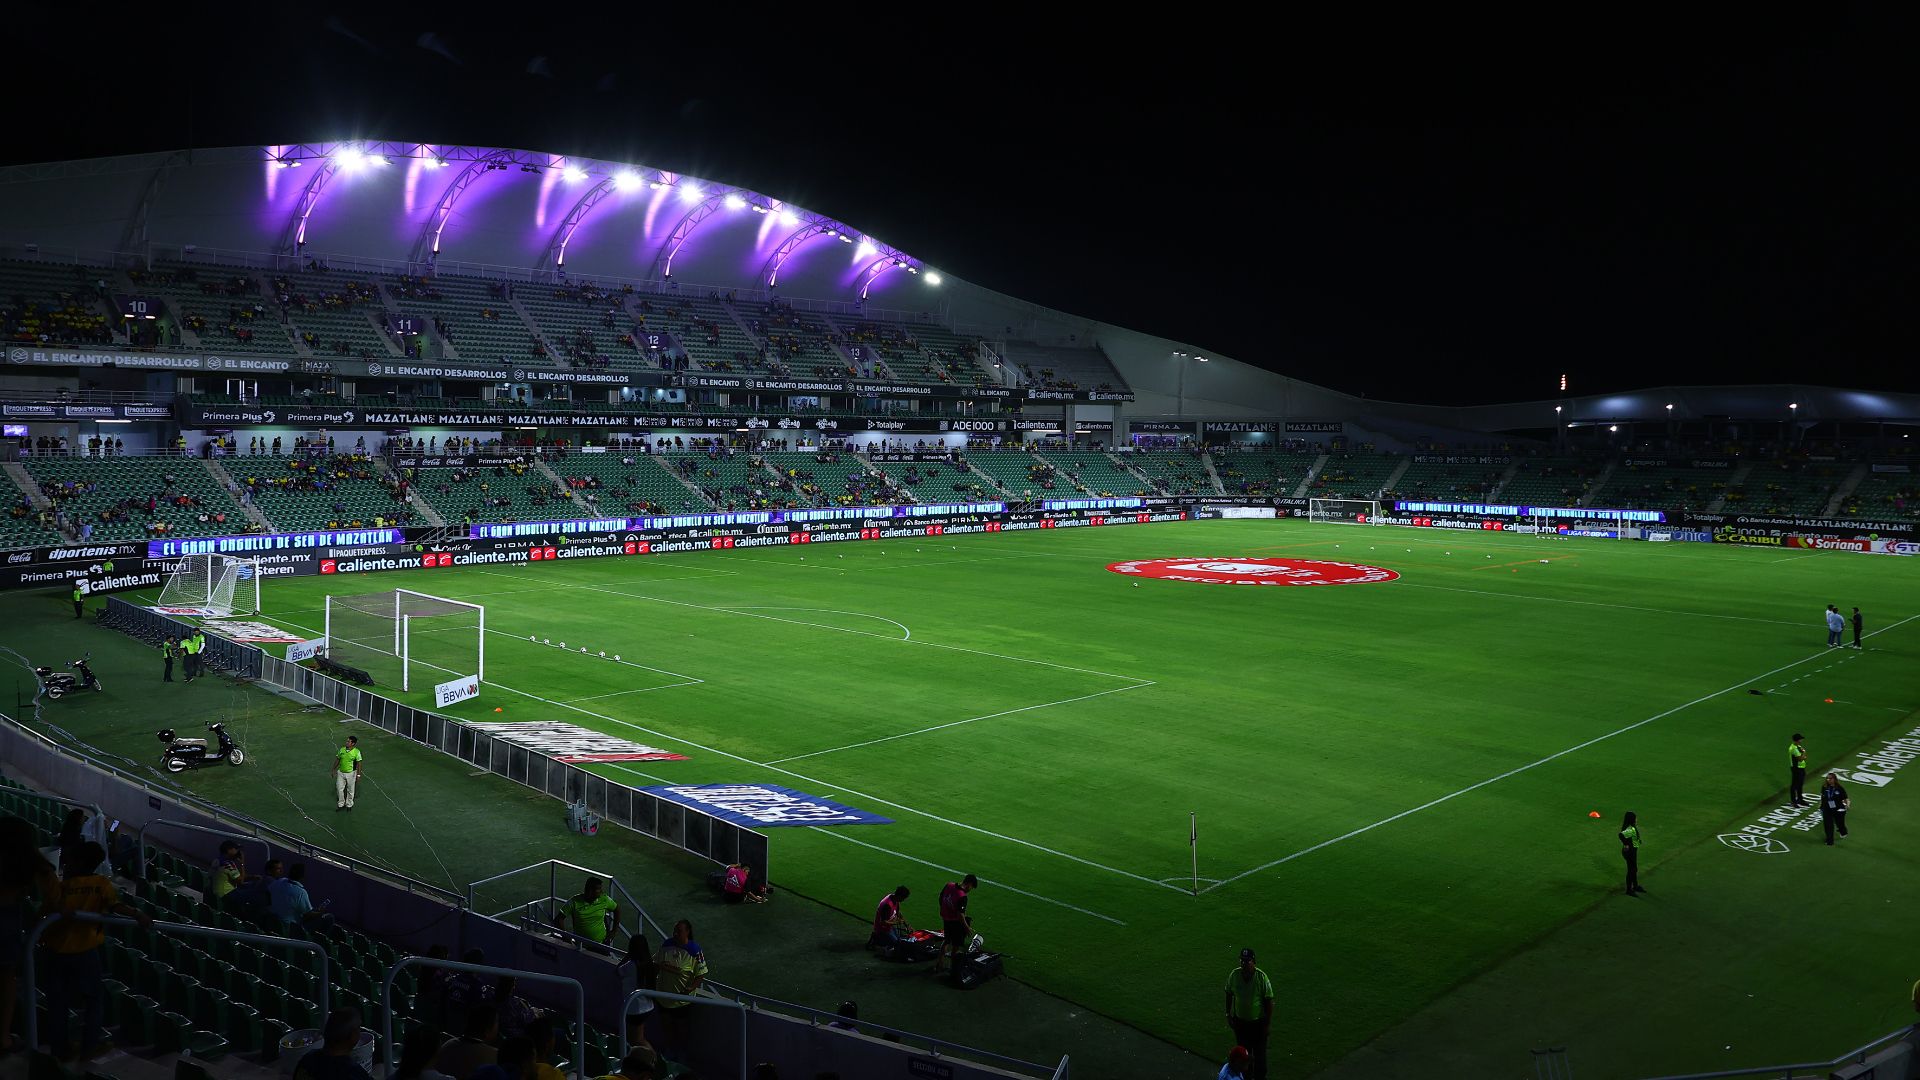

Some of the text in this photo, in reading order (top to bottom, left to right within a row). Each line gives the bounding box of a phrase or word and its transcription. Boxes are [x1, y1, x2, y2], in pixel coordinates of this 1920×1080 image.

[129, 301, 147, 313] 10
[398, 320, 411, 330] 11
[648, 335, 659, 345] 12
[33, 352, 200, 368] EL ENCANTO DESARROLLOS
[225, 360, 289, 370] EL ENCANTO
[384, 366, 507, 379] EL ENCANTO DESARROLLOS
[538, 373, 575, 381] ENCANTO
[576, 374, 629, 383] DESARROLLOS
[700, 378, 740, 387] EL ENCANTO
[756, 381, 843, 391] EL ENCANTO DESARROLLOS
[865, 385, 892, 393] ENCANTO
[893, 386, 932, 394] DESARROLLOS
[1036, 390, 1073, 399] caliente.mx
[202, 411, 263, 421] Primera Plus
[288, 413, 343, 422] Primera Plus
[875, 421, 904, 430] Totalplay
[1018, 420, 1058, 430] caliente.mx
[1081, 422, 1112, 430] caliente.mx
[1400, 502, 1406, 510] EL
[784, 512, 790, 522] EL
[836, 510, 843, 519] DE
[856, 509, 863, 518] DE
[1104, 515, 1136, 525] caliente.mx
[1150, 513, 1180, 522] caliente.mx
[1366, 516, 1412, 525] caliente.mx
[644, 519, 650, 528] EL
[653, 517, 672, 528] GRAN
[674, 516, 701, 527] ORGULLO
[704, 516, 711, 526] DE
[713, 515, 725, 525] SER
[727, 514, 735, 524] DE
[1001, 521, 1040, 531] caliente.mx
[1055, 518, 1090, 528] caliente.mx
[1431, 518, 1482, 529] caliente.mx
[480, 526, 488, 537] EL
[491, 525, 512, 537] GRAN
[515, 523, 548, 536] ORGULLO
[551, 522, 560, 534] DE
[562, 522, 576, 533] SER
[578, 521, 587, 532] DE
[698, 529, 743, 538] calinte.mx
[880, 527, 925, 538] caliente.mx
[943, 523, 985, 534] caliente.mx
[1503, 523, 1557, 534] cali.mx
[565, 536, 608, 545] Primera Plus
[734, 535, 789, 548] caliente.mx
[810, 531, 860, 543] caliente.mx
[163, 542, 176, 555] EL
[181, 540, 215, 554] GRAN
[220, 537, 272, 552] ORGULLO
[276, 536, 289, 549] DE
[294, 535, 315, 547] SER
[319, 534, 332, 546] DE
[650, 540, 711, 552] caliente.mx
[1815, 540, 1863, 550] Soriana
[49, 545, 136, 560] dportenis.mx
[336, 547, 386, 558] PAQUETEXPRESS
[557, 546, 623, 559] caliente.mx
[453, 551, 528, 565] caliente.mx
[337, 556, 421, 573] caliente.mx
[257, 565, 294, 575] Steren
[20, 569, 88, 582] Primera Plus
[90, 573, 160, 592] caliente.mx
[443, 688, 467, 704] BBVA
